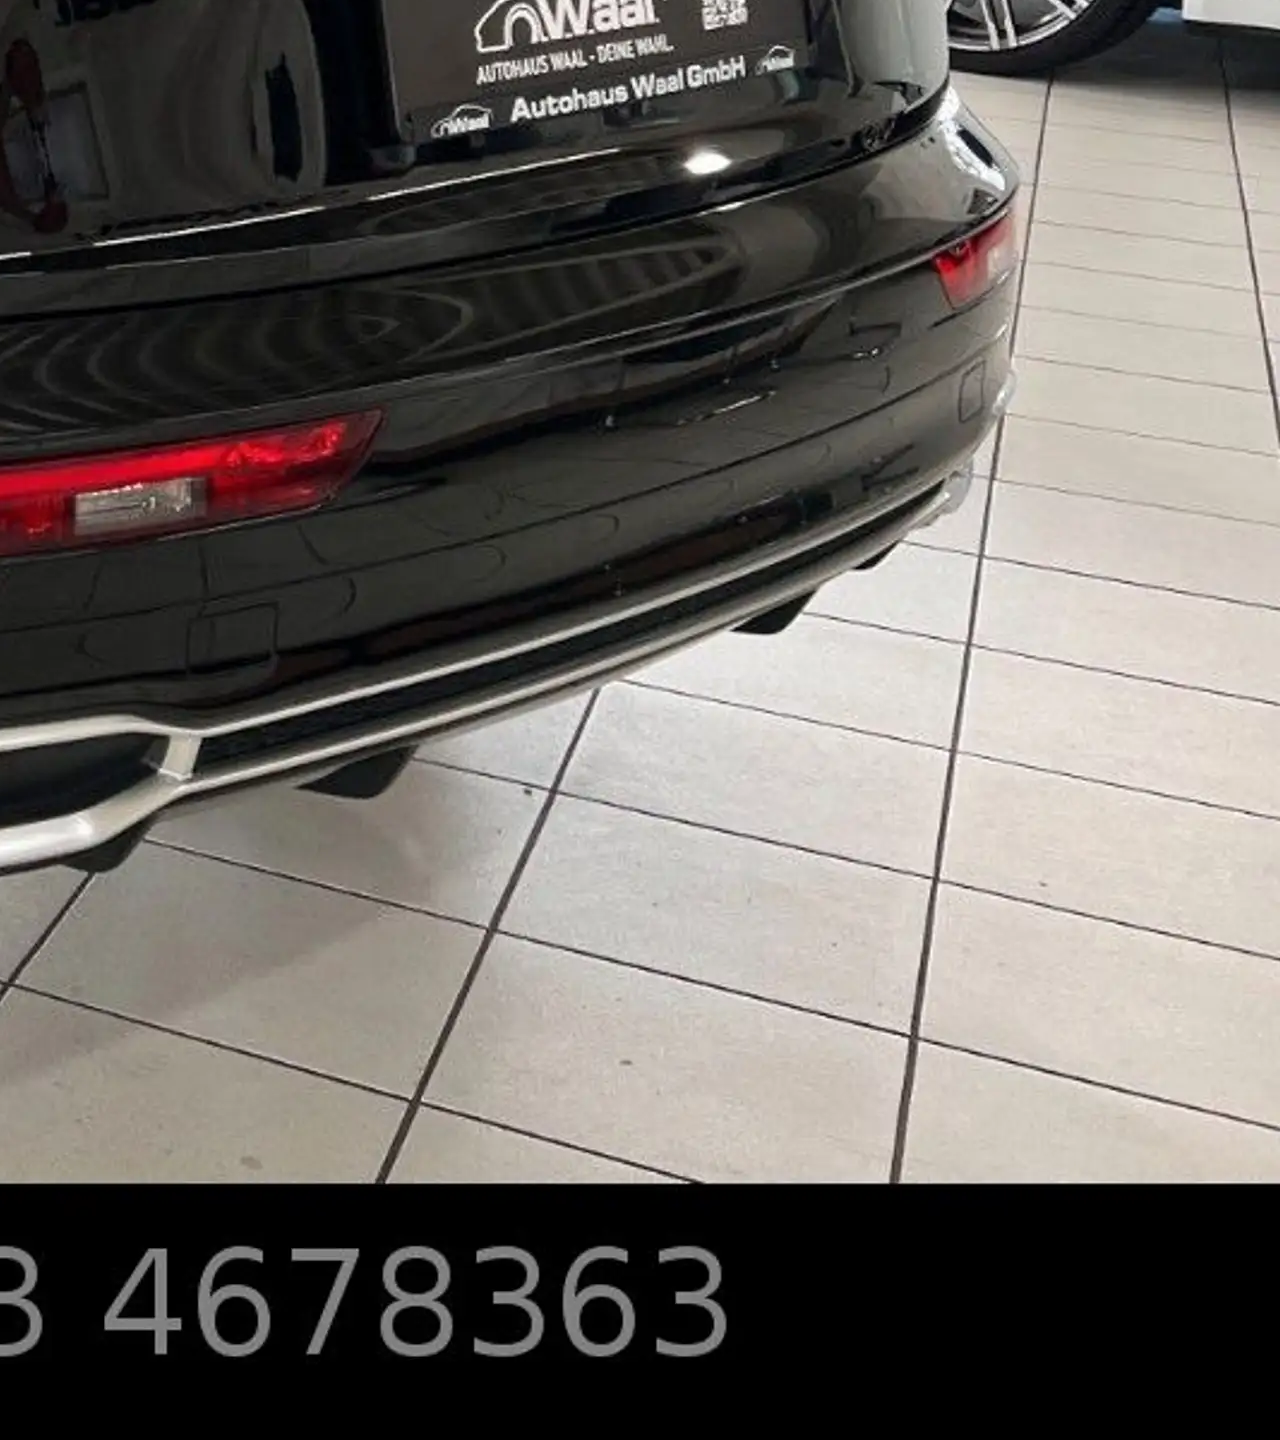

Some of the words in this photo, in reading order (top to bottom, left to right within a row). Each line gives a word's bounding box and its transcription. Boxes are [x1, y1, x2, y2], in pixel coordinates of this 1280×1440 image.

[476, 54, 550, 85] AUTOHAUS
[549, 48, 589, 72] WAAL
[596, 40, 636, 64] DEINE
[510, 83, 629, 125] Autohaus
[630, 66, 685, 101] Waal
[686, 55, 746, 89] GmbH
